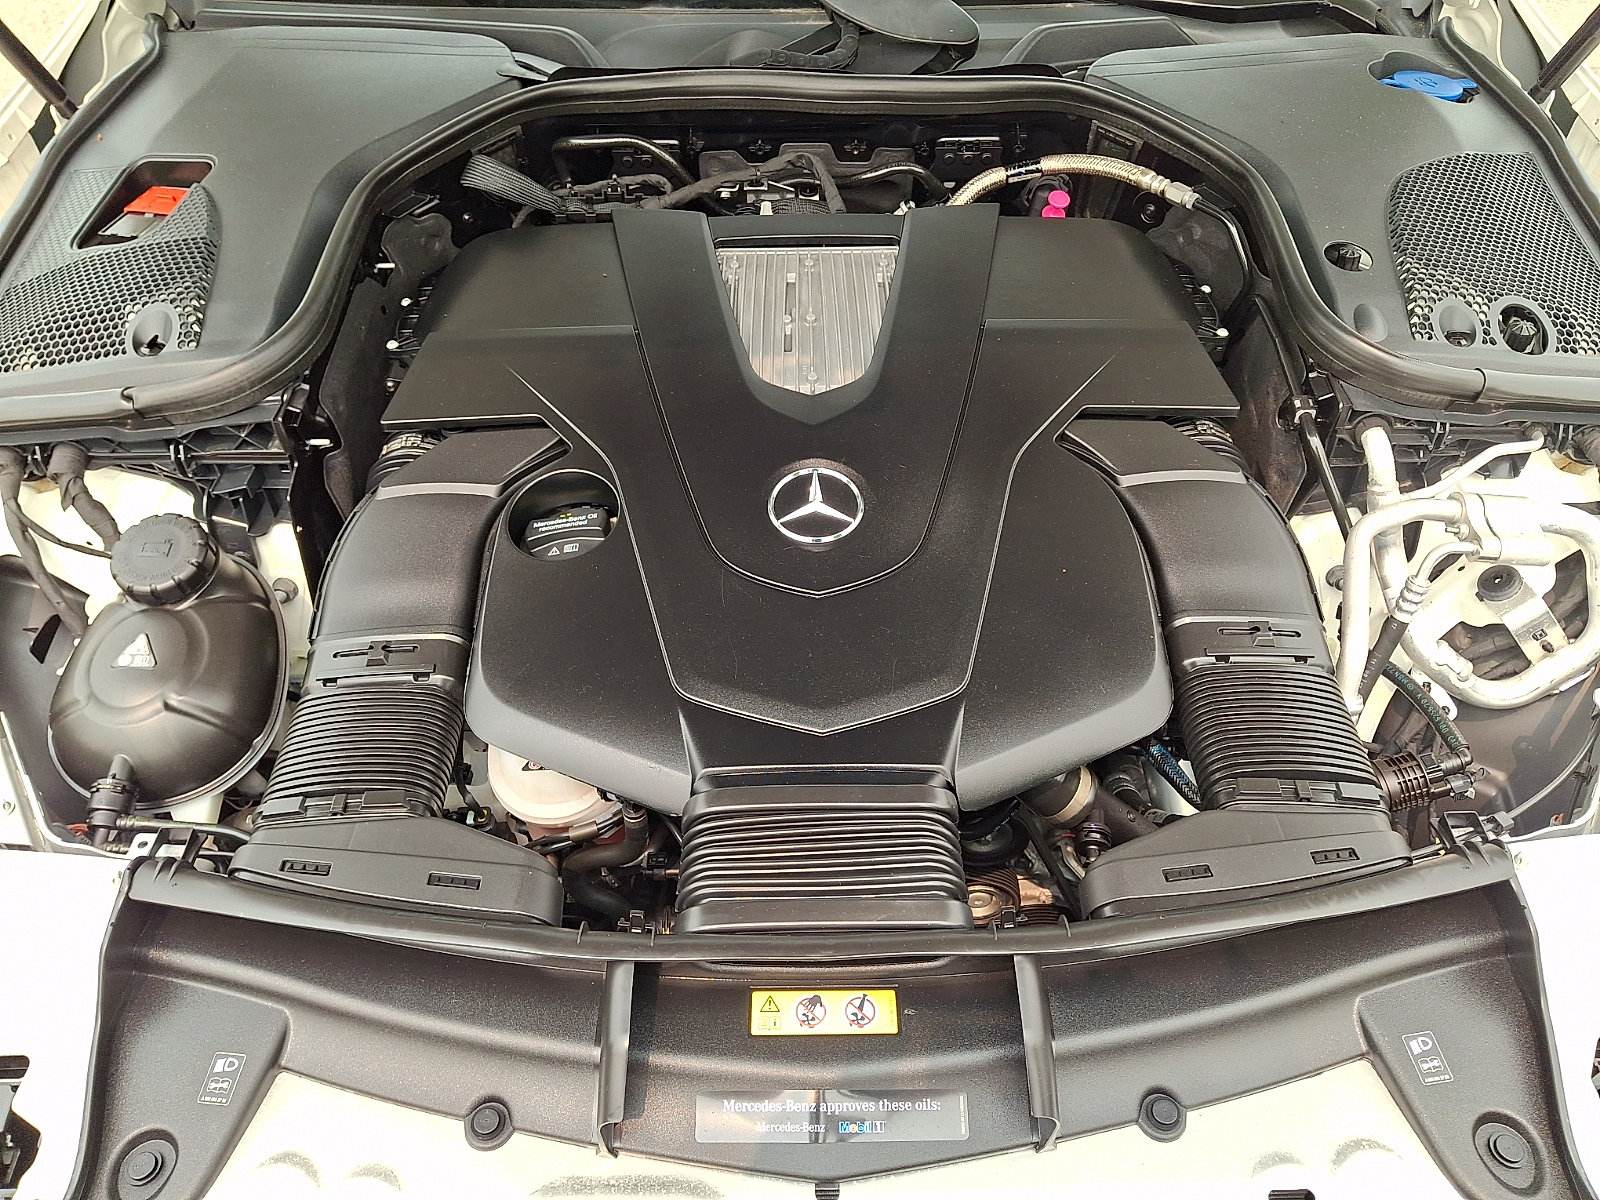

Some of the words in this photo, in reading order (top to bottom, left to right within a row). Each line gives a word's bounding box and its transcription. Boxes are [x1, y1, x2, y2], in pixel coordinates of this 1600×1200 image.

[533, 514, 586, 528] Mercedes-Benz
[538, 520, 588, 531] recommended
[722, 1099, 817, 1113] Mercedes-Benz
[819, 1101, 876, 1116] approves
[878, 1098, 912, 1112] these
[914, 1098, 941, 1111] oils:
[756, 1121, 826, 1133] Mercedes-Benz
[838, 1121, 873, 1134] Mobil
